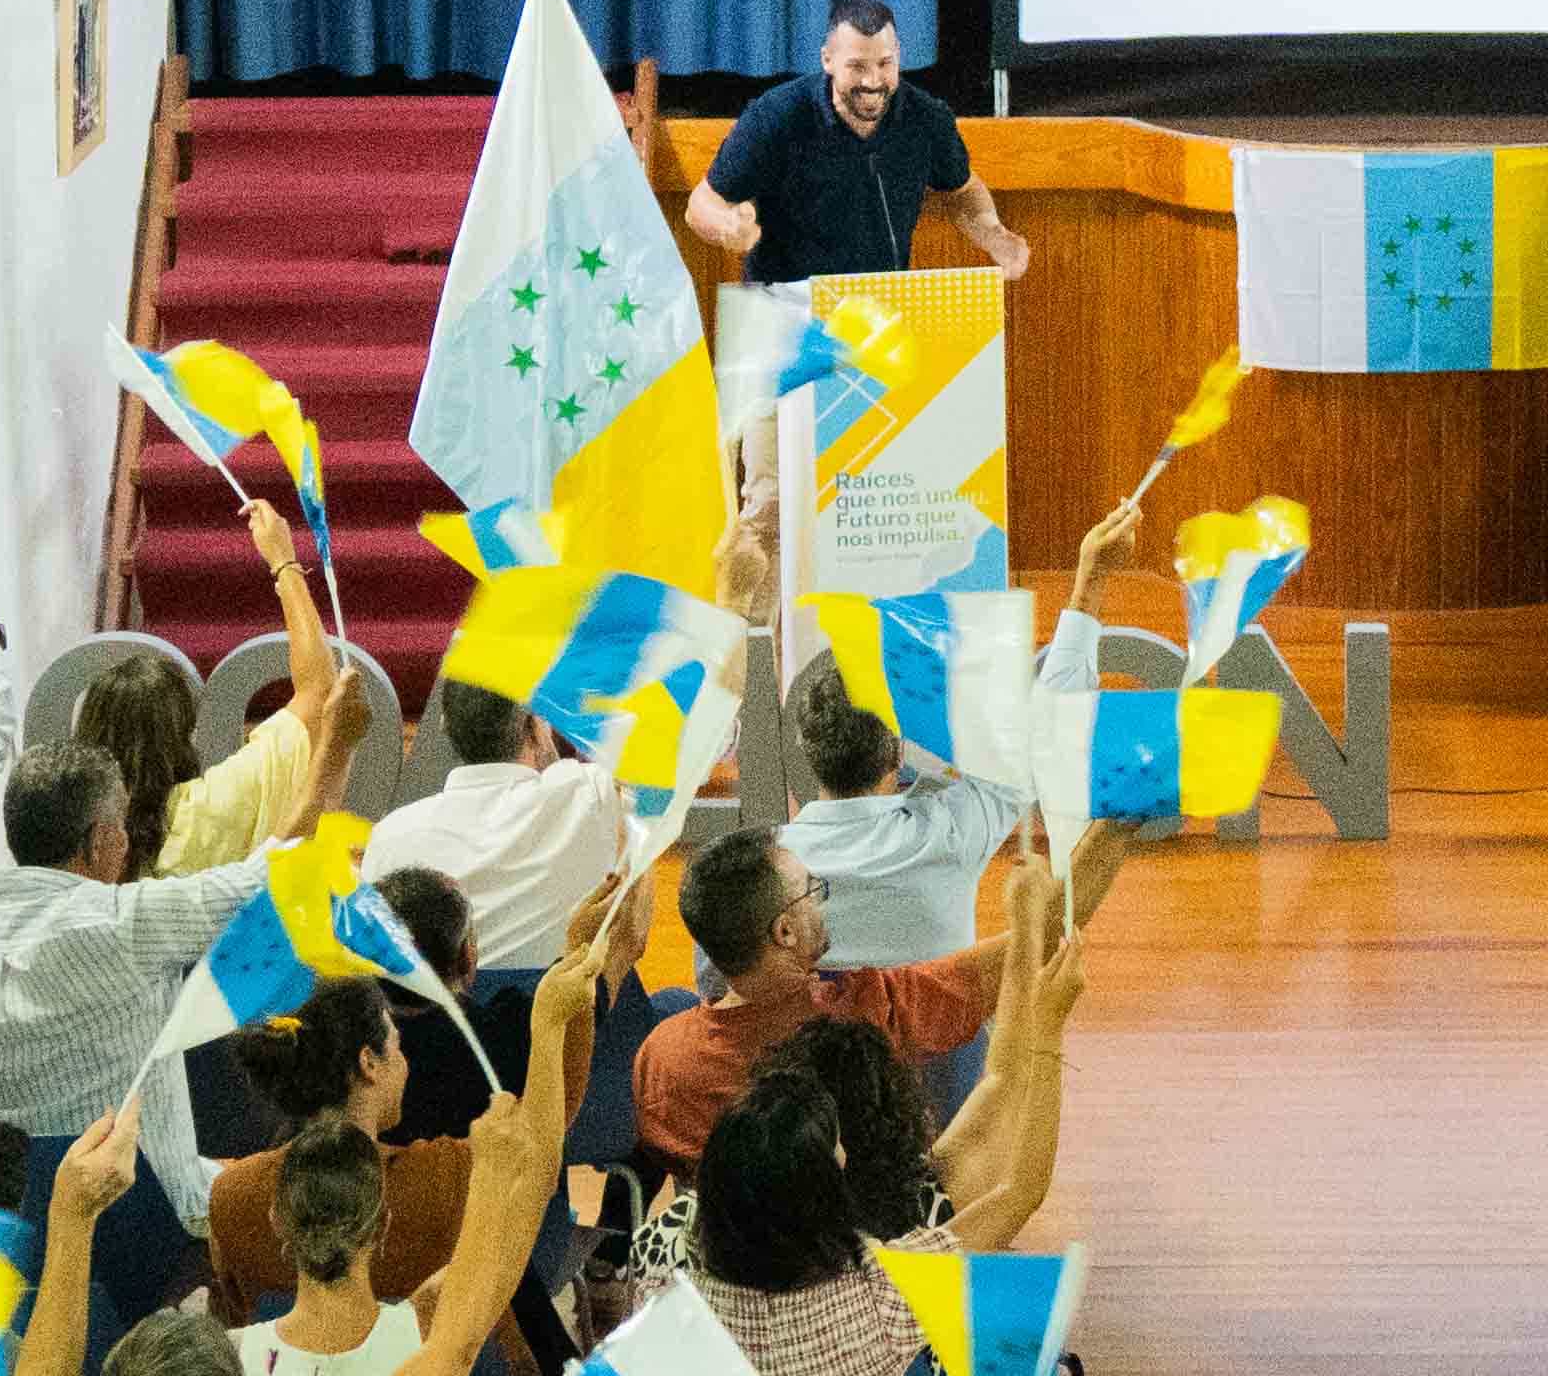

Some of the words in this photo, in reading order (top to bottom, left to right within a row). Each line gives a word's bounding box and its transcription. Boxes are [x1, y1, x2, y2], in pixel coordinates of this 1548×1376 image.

[836, 471, 915, 490] Raíces
[836, 494, 877, 510] que
[882, 492, 920, 507] nos
[836, 511, 911, 529] Futuro
[916, 510, 956, 529] que
[836, 533, 873, 548] nos
